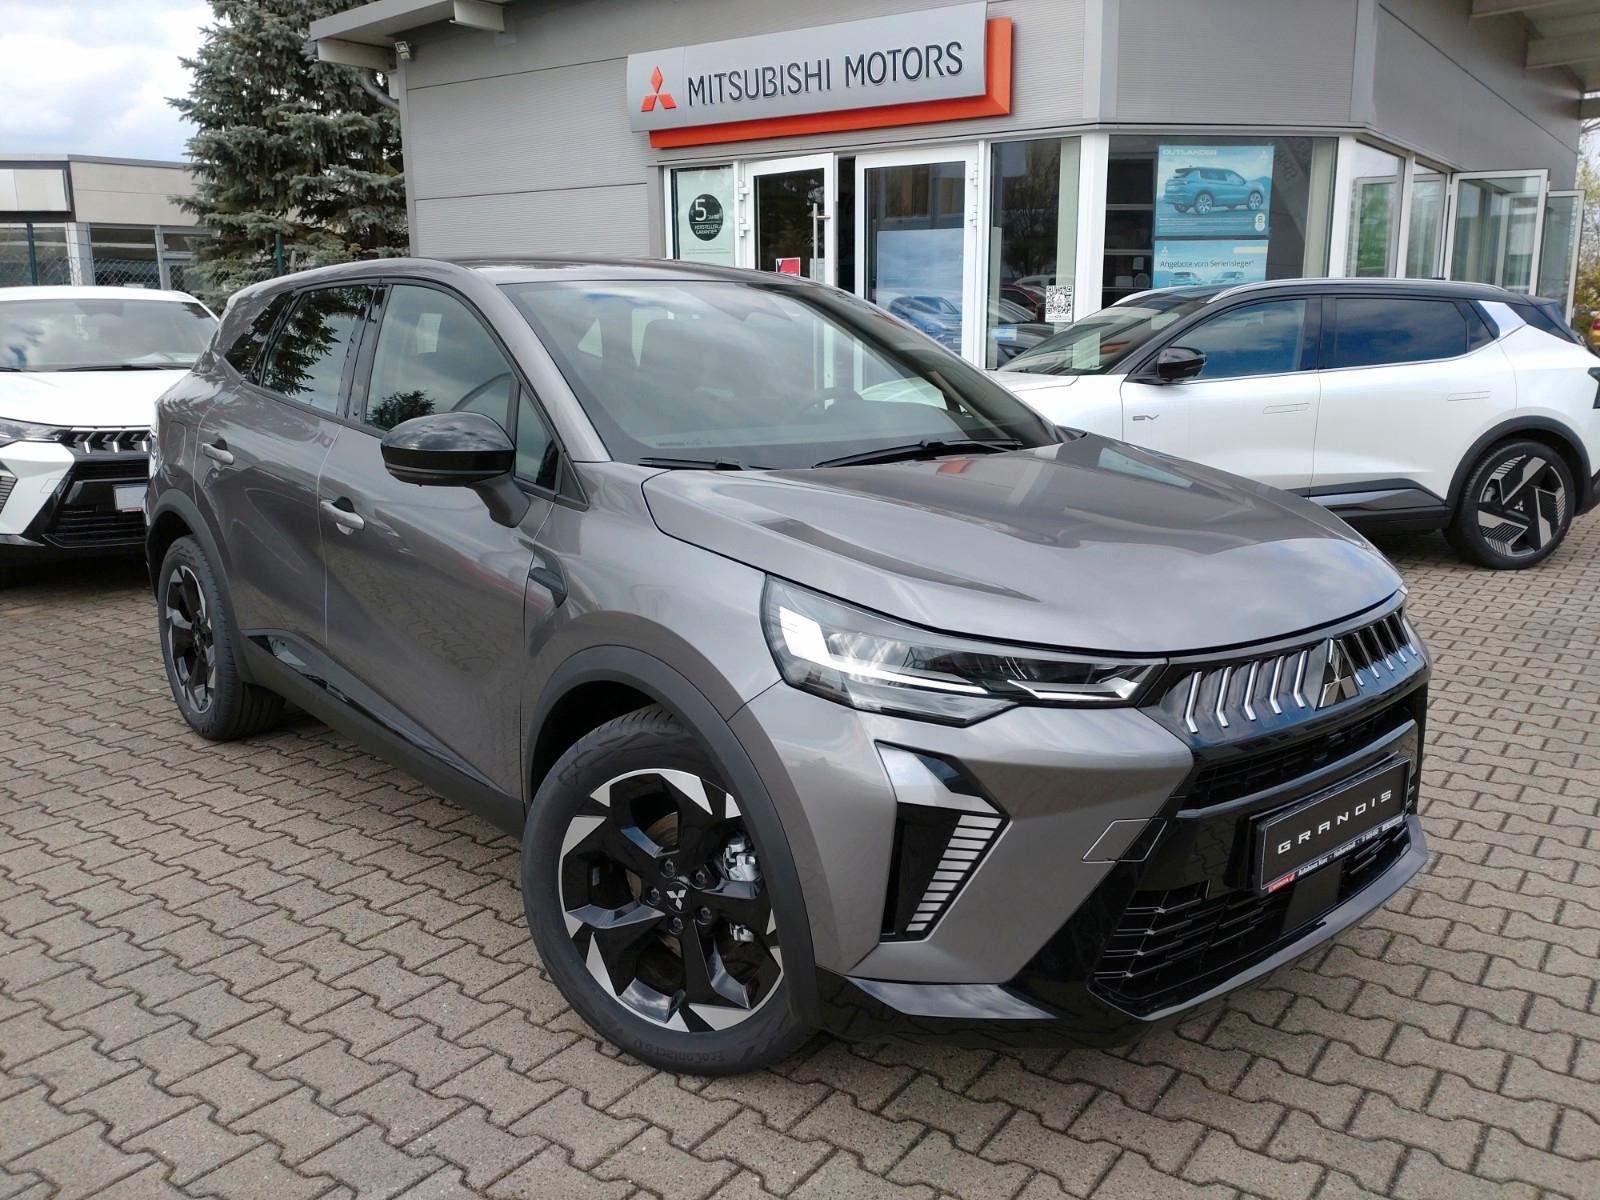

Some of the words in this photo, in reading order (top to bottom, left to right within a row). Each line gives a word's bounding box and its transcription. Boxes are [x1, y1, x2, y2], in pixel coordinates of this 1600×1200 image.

[688, 58, 831, 106] MITSUBISHI
[845, 41, 964, 88] MOTORS
[1162, 148, 1217, 157] OUTLANDER
[695, 199, 706, 221] 5
[1160, 260, 1193, 269] Angebote
[1277, 789, 1392, 855] GRANDIS
